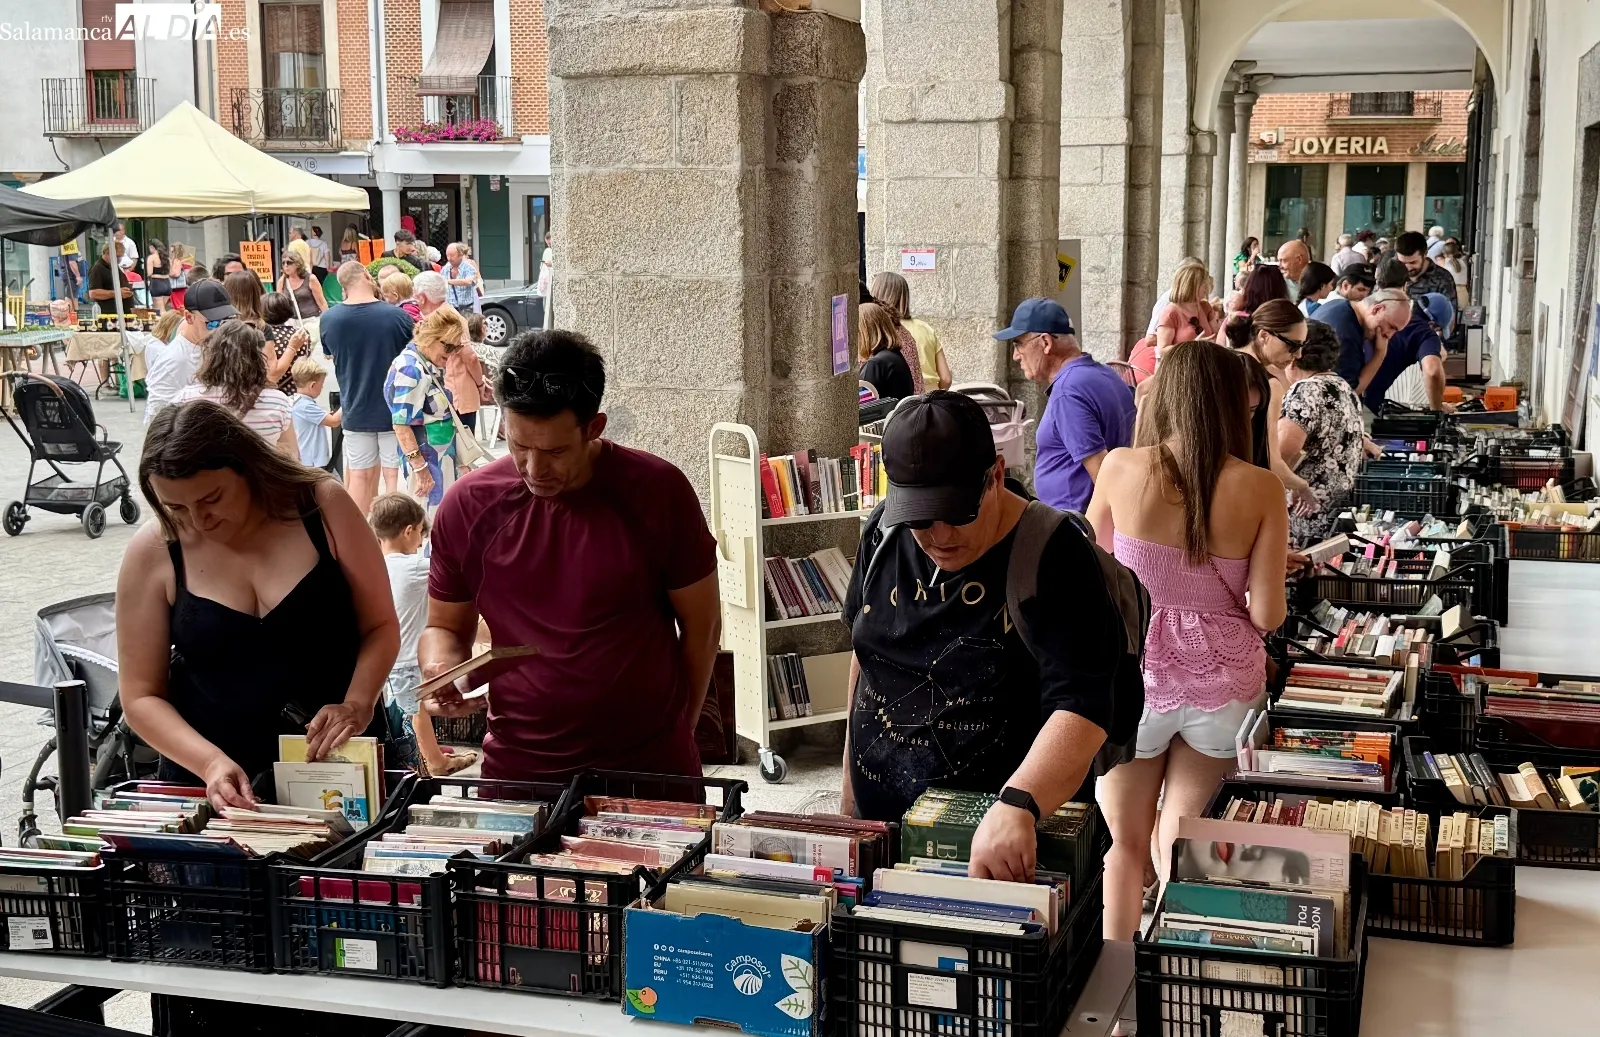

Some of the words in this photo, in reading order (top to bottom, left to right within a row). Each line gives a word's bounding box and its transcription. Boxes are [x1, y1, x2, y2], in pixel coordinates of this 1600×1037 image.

[1289, 136, 1389, 155] JOYERIA
[243, 244, 269, 252] MIEL
[653, 954, 671, 962] CHINA
